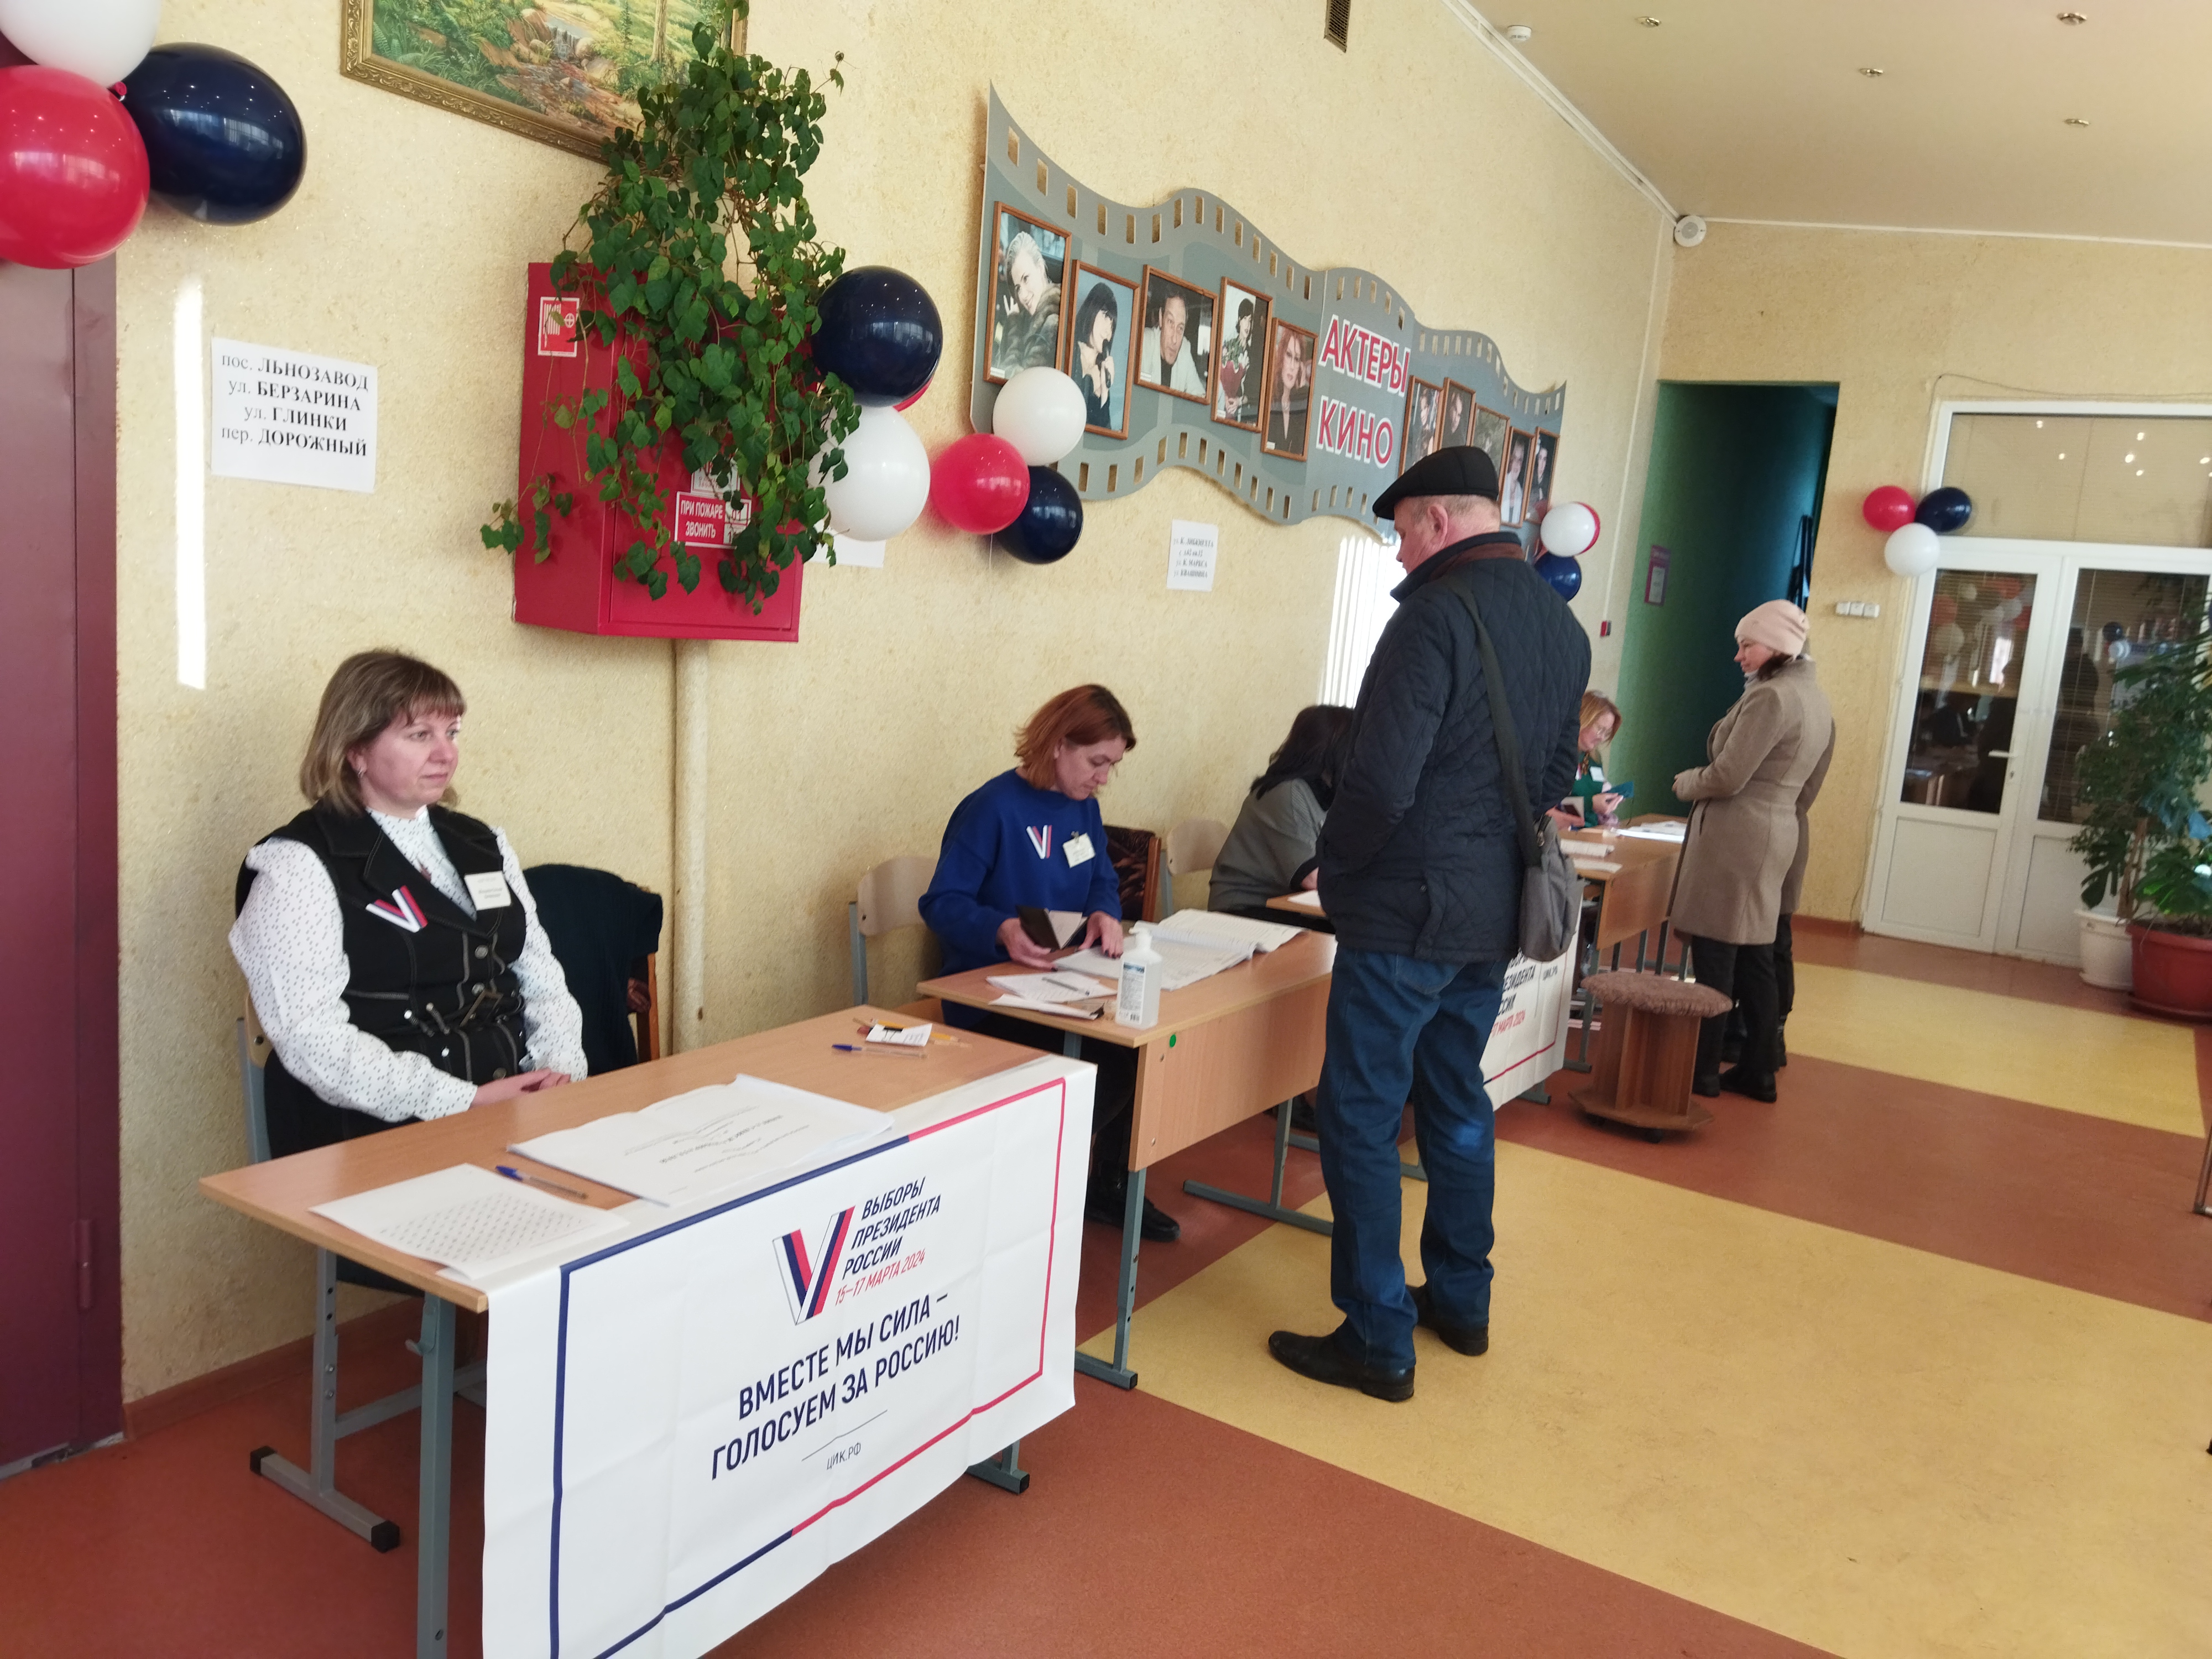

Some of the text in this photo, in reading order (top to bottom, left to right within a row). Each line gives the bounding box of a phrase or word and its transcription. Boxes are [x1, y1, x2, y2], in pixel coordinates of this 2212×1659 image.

[222, 354, 369, 392] пос. ЛЬНОЗАВОД
[1319, 315, 1410, 396] АКТЕРЫ
[228, 380, 361, 411] ул. БЕРЗАРИНА
[244, 406, 347, 431] ул. ГЛИНКИ
[1317, 396, 1393, 468] КИНО
[222, 427, 367, 457] пер. ДОРОЖНЫЙ
[680, 500, 723, 519] ПРИ ПОЖАРЕ
[685, 521, 716, 539] ЗВОНИТЬ
[1503, 964, 1536, 992] ЕЗИДЕНТА
[861, 1176, 926, 1220] ВЫБОРЫ
[851, 1194, 941, 1250] ПРЕЗИДЕНТА
[842, 1236, 903, 1280] РОССИИ
[864, 1262, 900, 1292] МАРТА
[901, 1248, 926, 1275] 2024
[739, 1344, 830, 1421] ВМЕСТЕ
[836, 1322, 875, 1366] МЫ
[879, 1294, 930, 1342] СИЛА
[712, 1315, 960, 1481] ГОЛОСУЕМ ЗА РОССИЮ!
[827, 1442, 862, 1470] ЦИК.РФ
